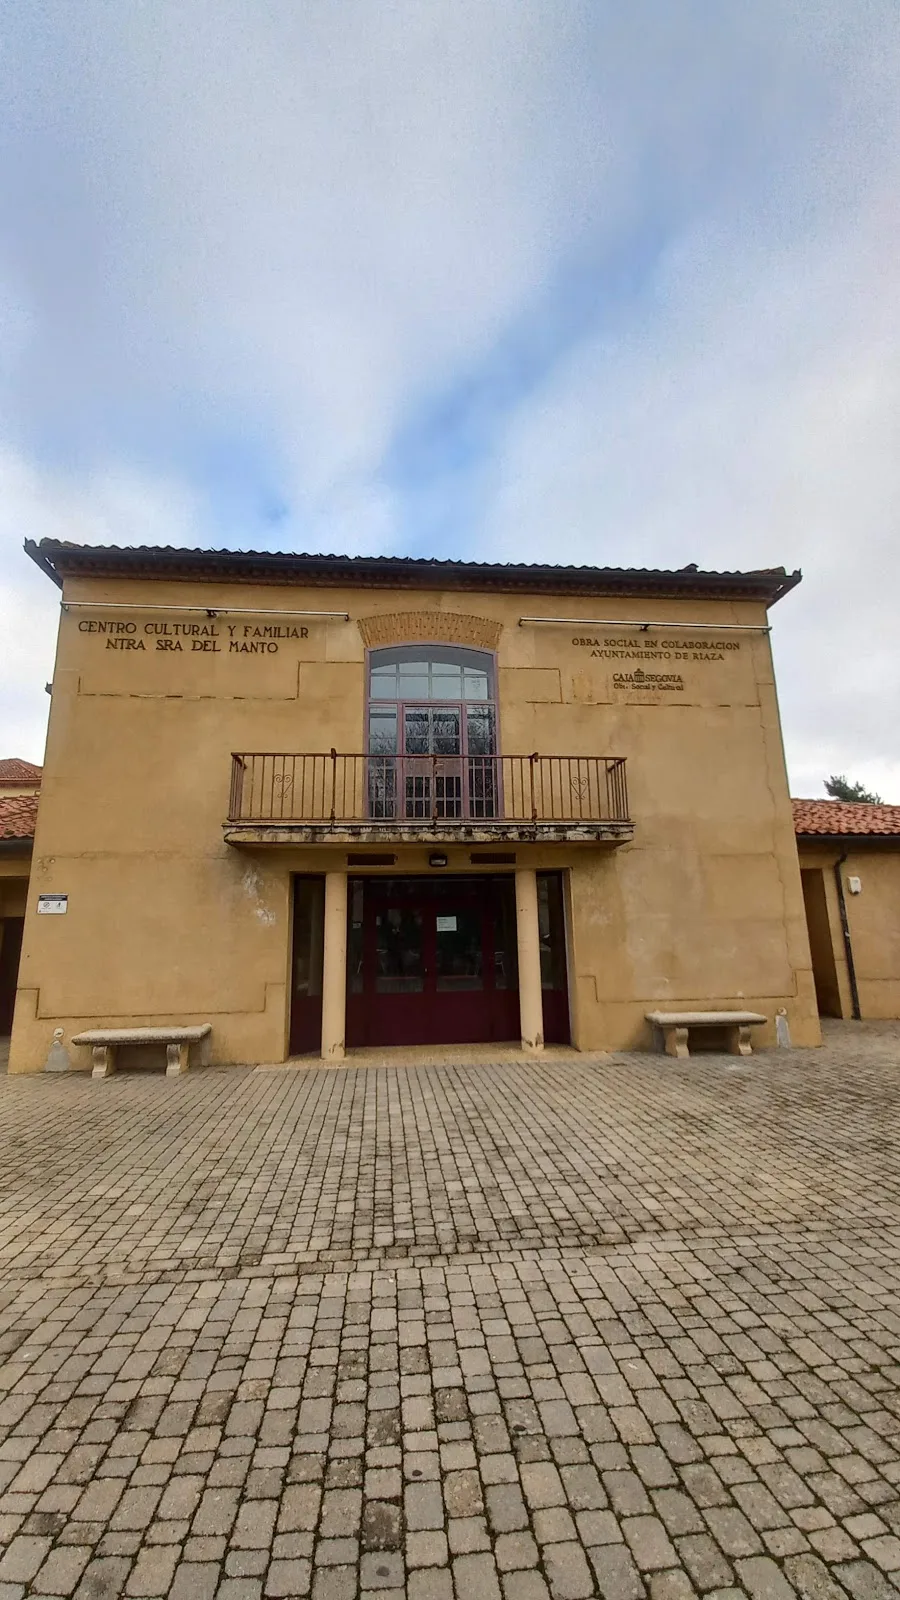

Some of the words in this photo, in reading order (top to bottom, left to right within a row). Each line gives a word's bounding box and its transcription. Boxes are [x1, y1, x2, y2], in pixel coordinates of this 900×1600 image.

[78, 620, 137, 634] CENTRO
[144, 623, 219, 637] CULTURAL
[227, 625, 237, 637] Y
[243, 626, 309, 639] FAMILIAR
[105, 638, 146, 651] NTRA
[156, 639, 183, 651] SRA
[191, 640, 221, 652] DEL
[228, 641, 279, 653] MANTO
[572, 638, 600, 647] OBRA
[604, 639, 640, 648] SOCIAL
[644, 640, 658, 648] EN
[661, 641, 740, 651] COLABORACION
[590, 650, 671, 660] AYUNTAMIENTO
[675, 651, 688, 660] DE
[693, 652, 725, 661] RIAZA
[645, 674, 683, 683] SEGOVIA
